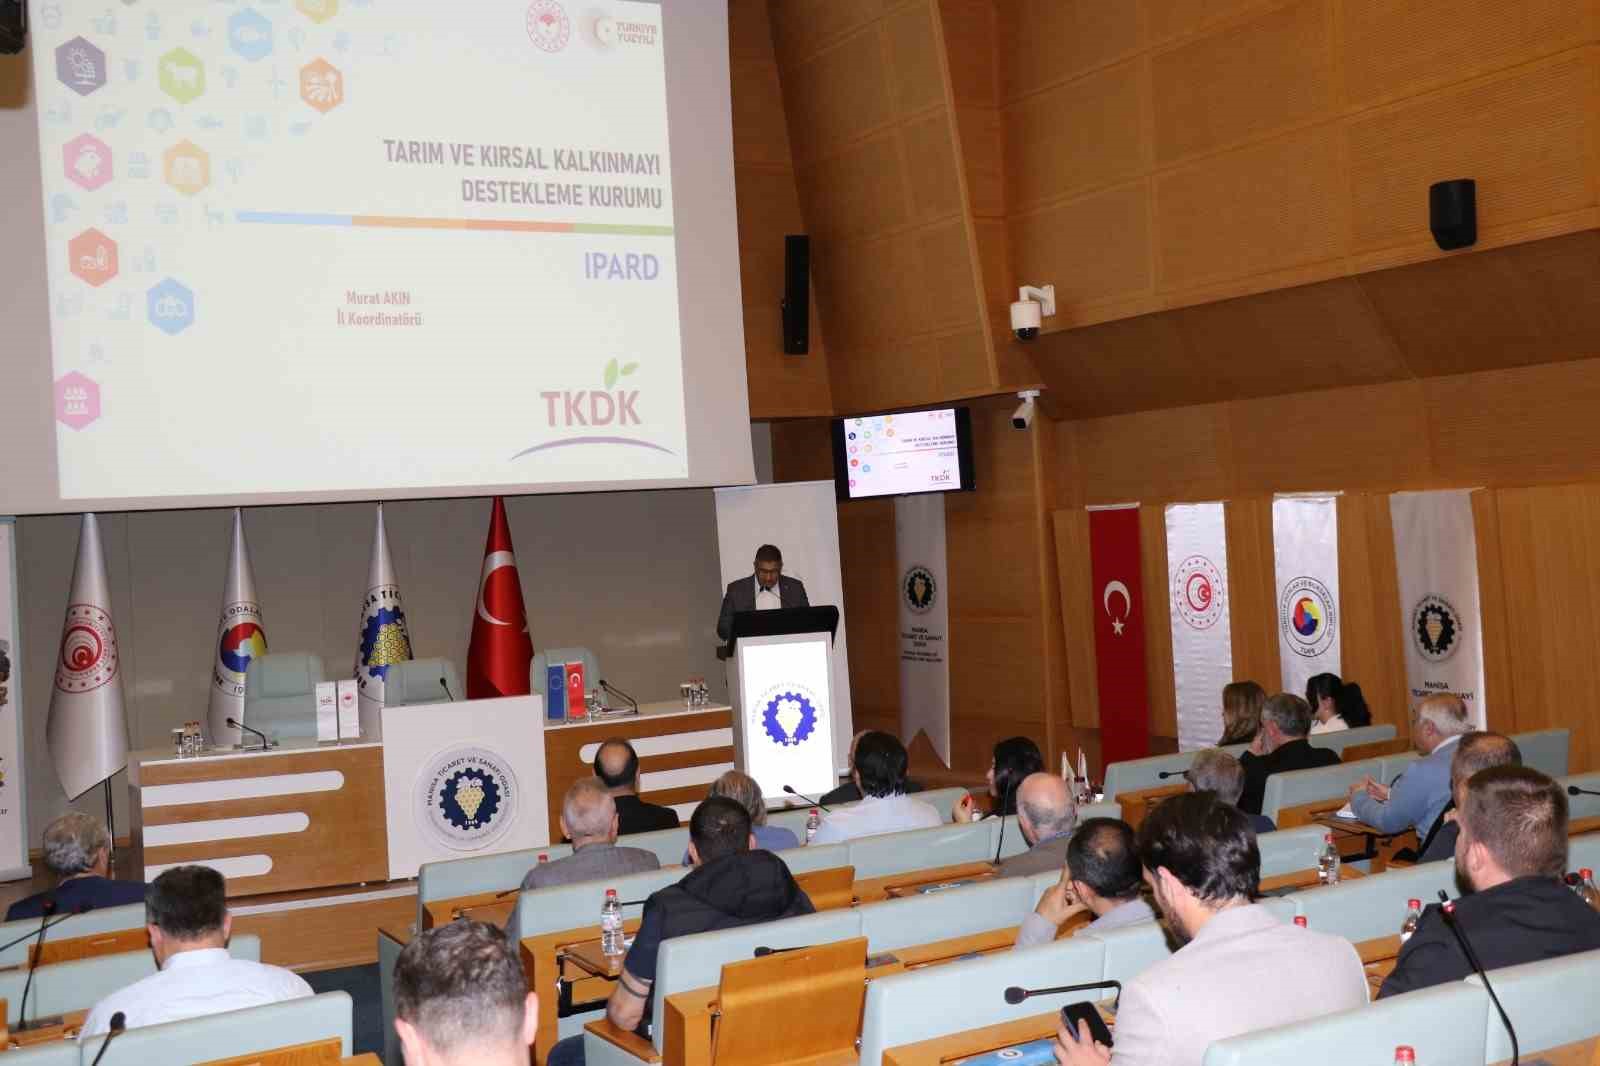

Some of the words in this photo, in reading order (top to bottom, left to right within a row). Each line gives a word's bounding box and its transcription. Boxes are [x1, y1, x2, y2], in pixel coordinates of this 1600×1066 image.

[383, 139, 444, 165] TARIM
[450, 143, 474, 166] VE
[480, 145, 548, 170] KIRSAL
[554, 149, 661, 176] KALKINMAYI
[462, 179, 583, 206] DESTEKLEME
[589, 185, 662, 209] KURUMU
[585, 252, 659, 280] IPARD
[346, 290, 380, 305] Murat
[384, 290, 411, 305] AKIN
[348, 312, 422, 326] Koordinatörü
[541, 390, 642, 427] TKDK
